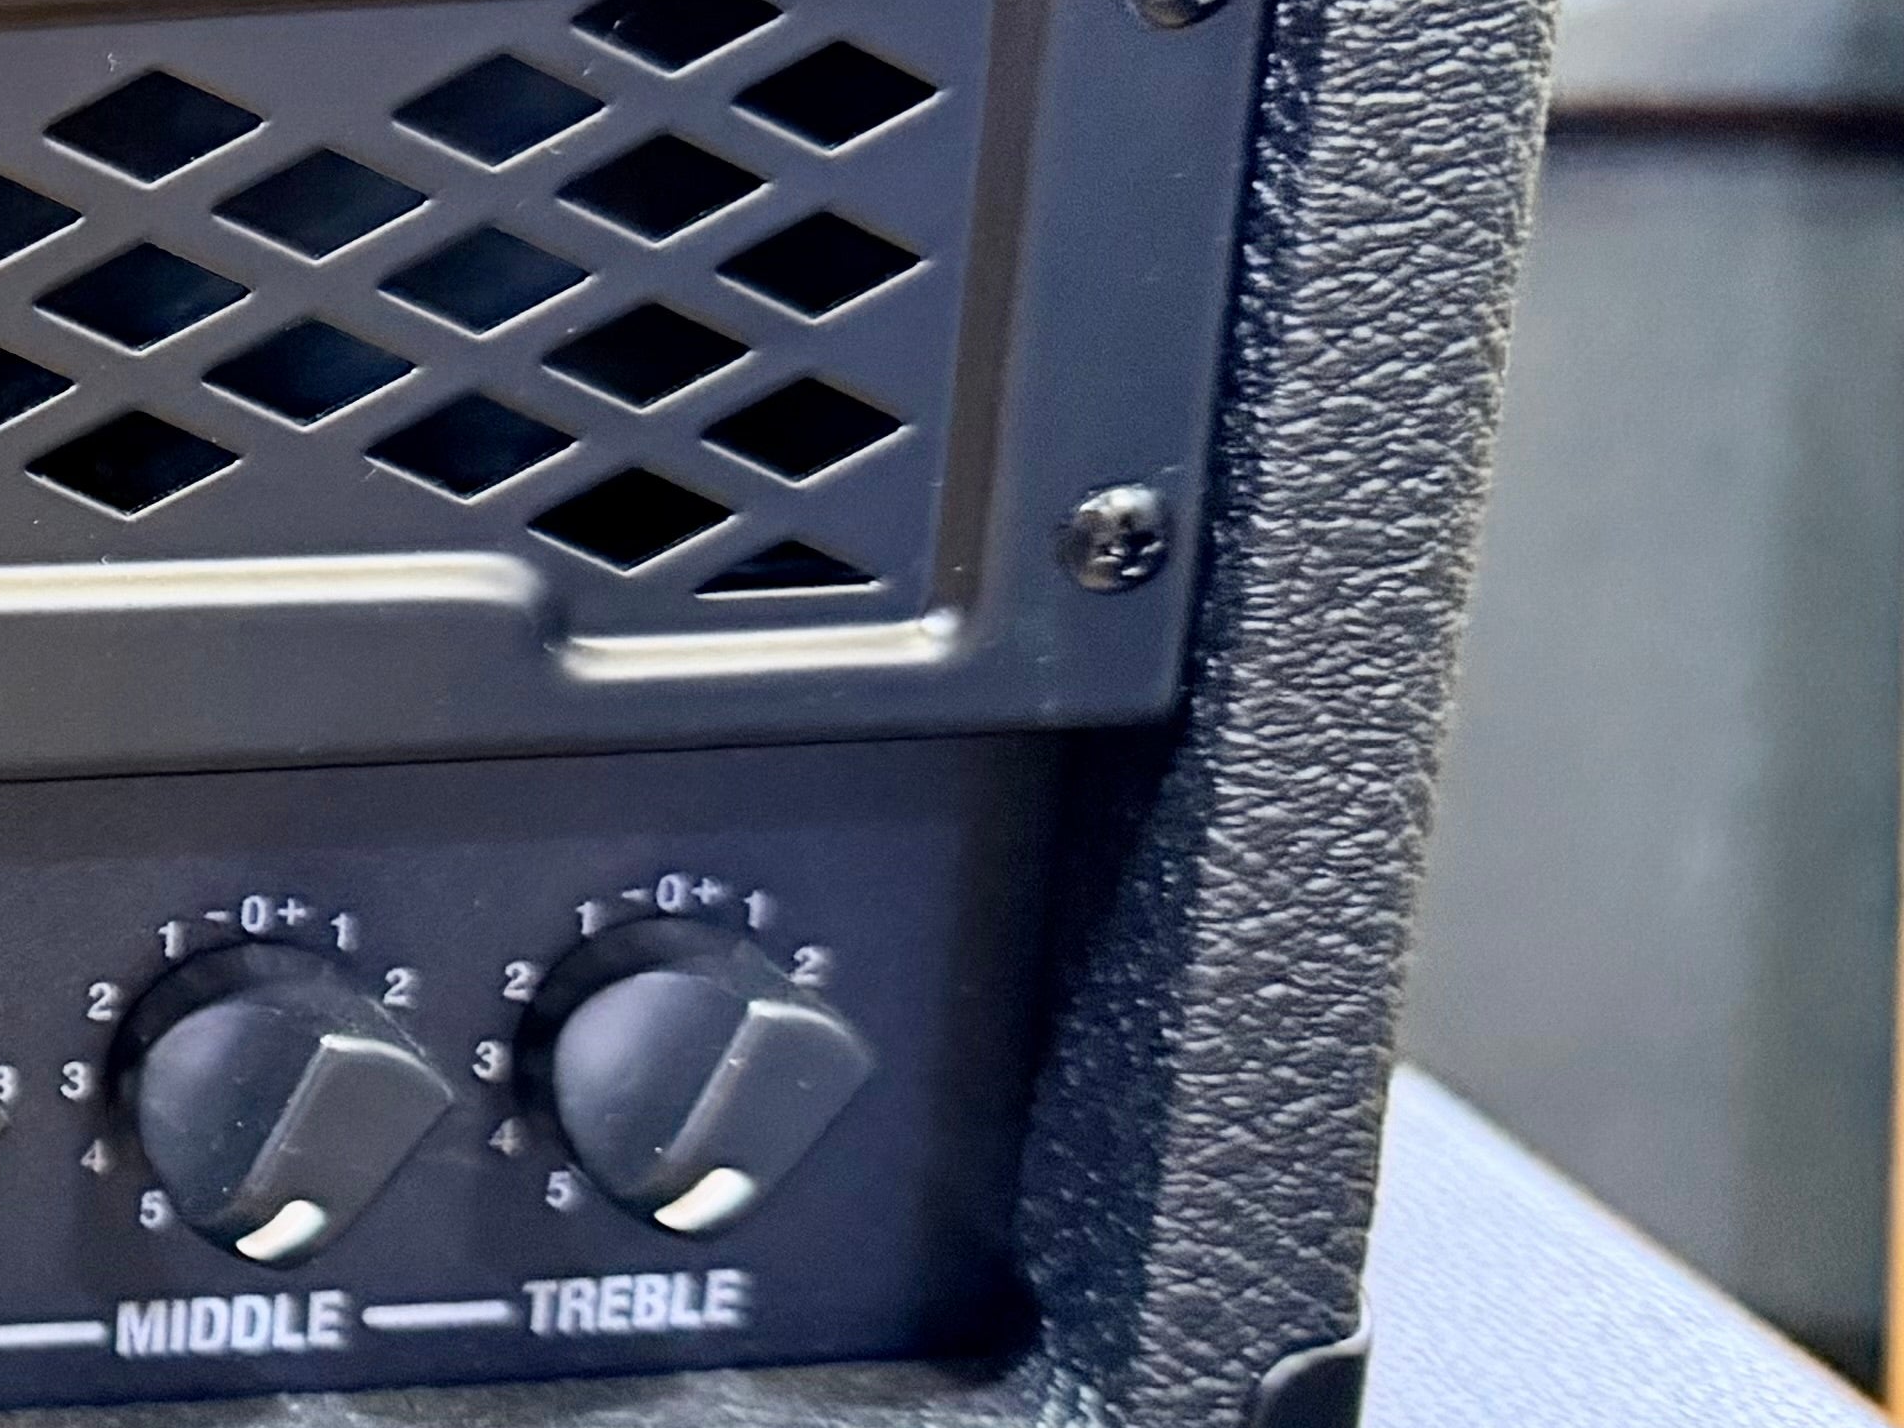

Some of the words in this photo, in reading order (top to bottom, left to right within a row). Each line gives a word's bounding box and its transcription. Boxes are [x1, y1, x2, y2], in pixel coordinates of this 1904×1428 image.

[576, 901, 602, 935] 1
[745, 892, 769, 928] 1
[158, 921, 183, 958] 1
[331, 913, 356, 949] 1
[504, 961, 534, 998] 2
[793, 947, 828, 985] 2
[88, 983, 115, 1019] 2
[384, 970, 415, 1006] 2
[472, 1043, 503, 1079] 3
[60, 1062, 88, 1099] 3
[490, 1120, 519, 1155] 4
[81, 1141, 107, 1171] 4
[546, 1172, 574, 1209] 5
[140, 1192, 166, 1226] 5
[523, 1271, 747, 1336] TREBLE
[114, 1292, 350, 1357] MIDDLE
